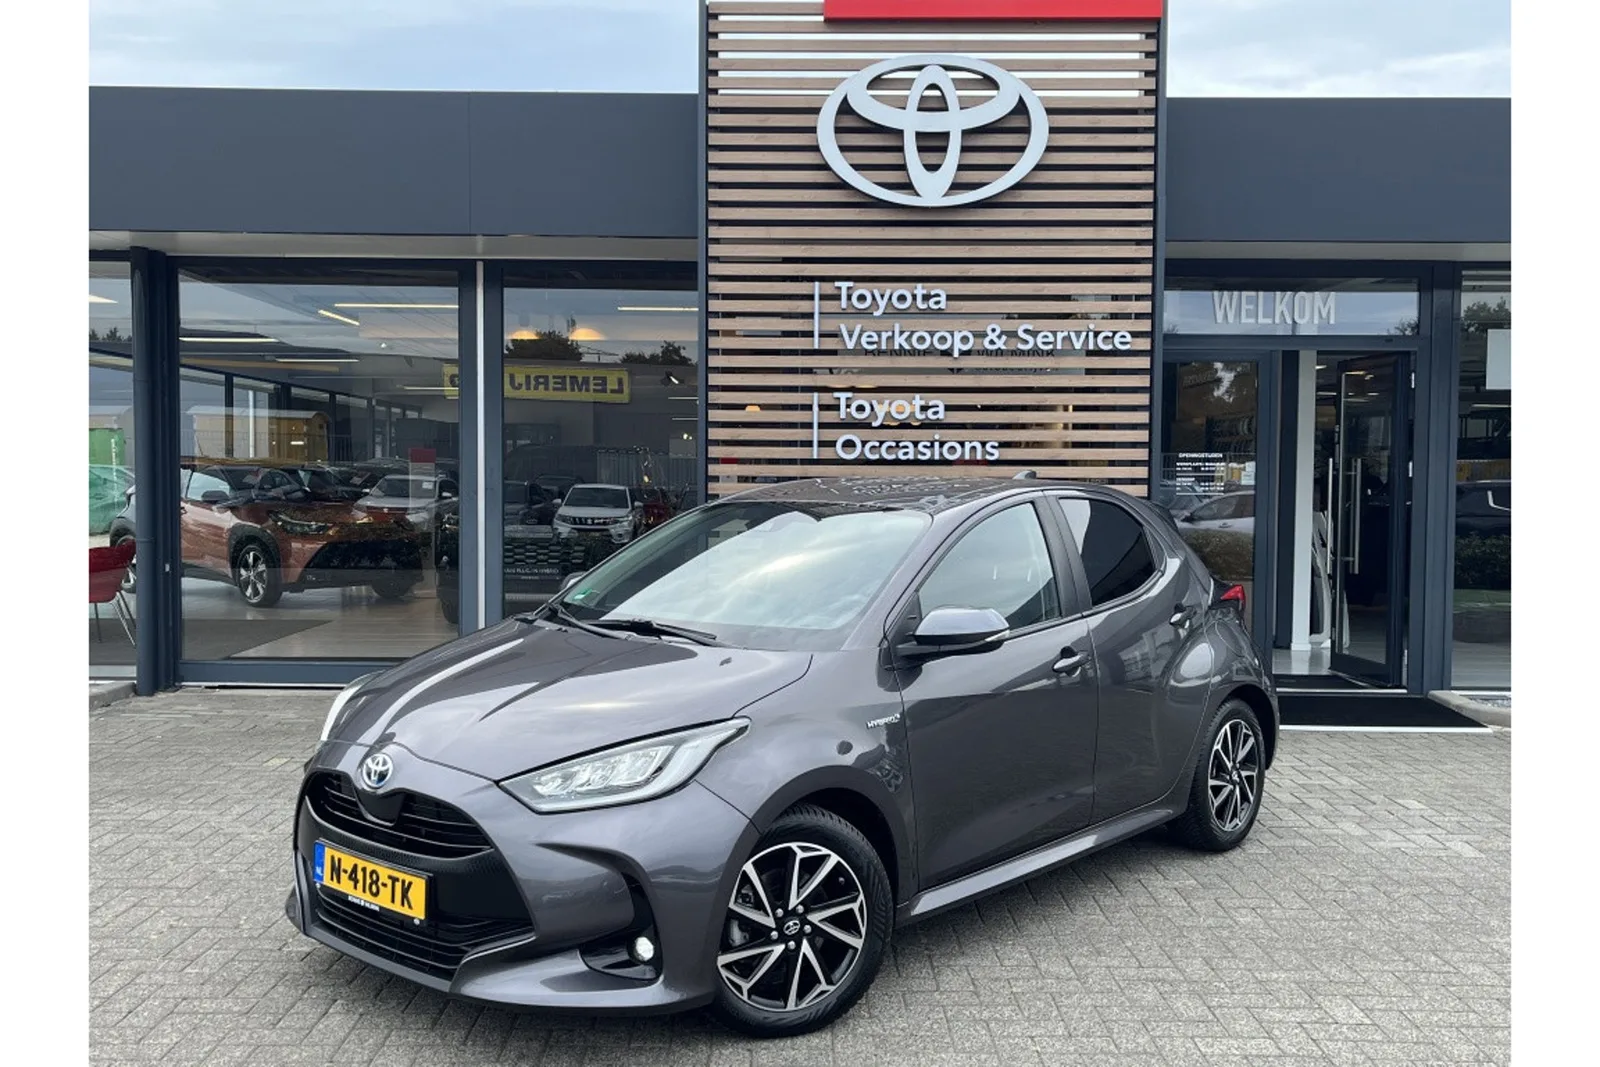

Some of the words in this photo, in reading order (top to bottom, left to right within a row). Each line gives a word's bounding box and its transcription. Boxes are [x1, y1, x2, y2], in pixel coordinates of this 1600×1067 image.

[834, 281, 947, 315] Toyota
[1212, 291, 1336, 324] WELKOM
[839, 323, 974, 358] Verkoop
[983, 323, 1007, 350] &
[1017, 323, 1133, 350] Service
[833, 392, 945, 426] Toyota
[835, 434, 1000, 461] Occasions
[329, 854, 414, 911] N-418-TK
